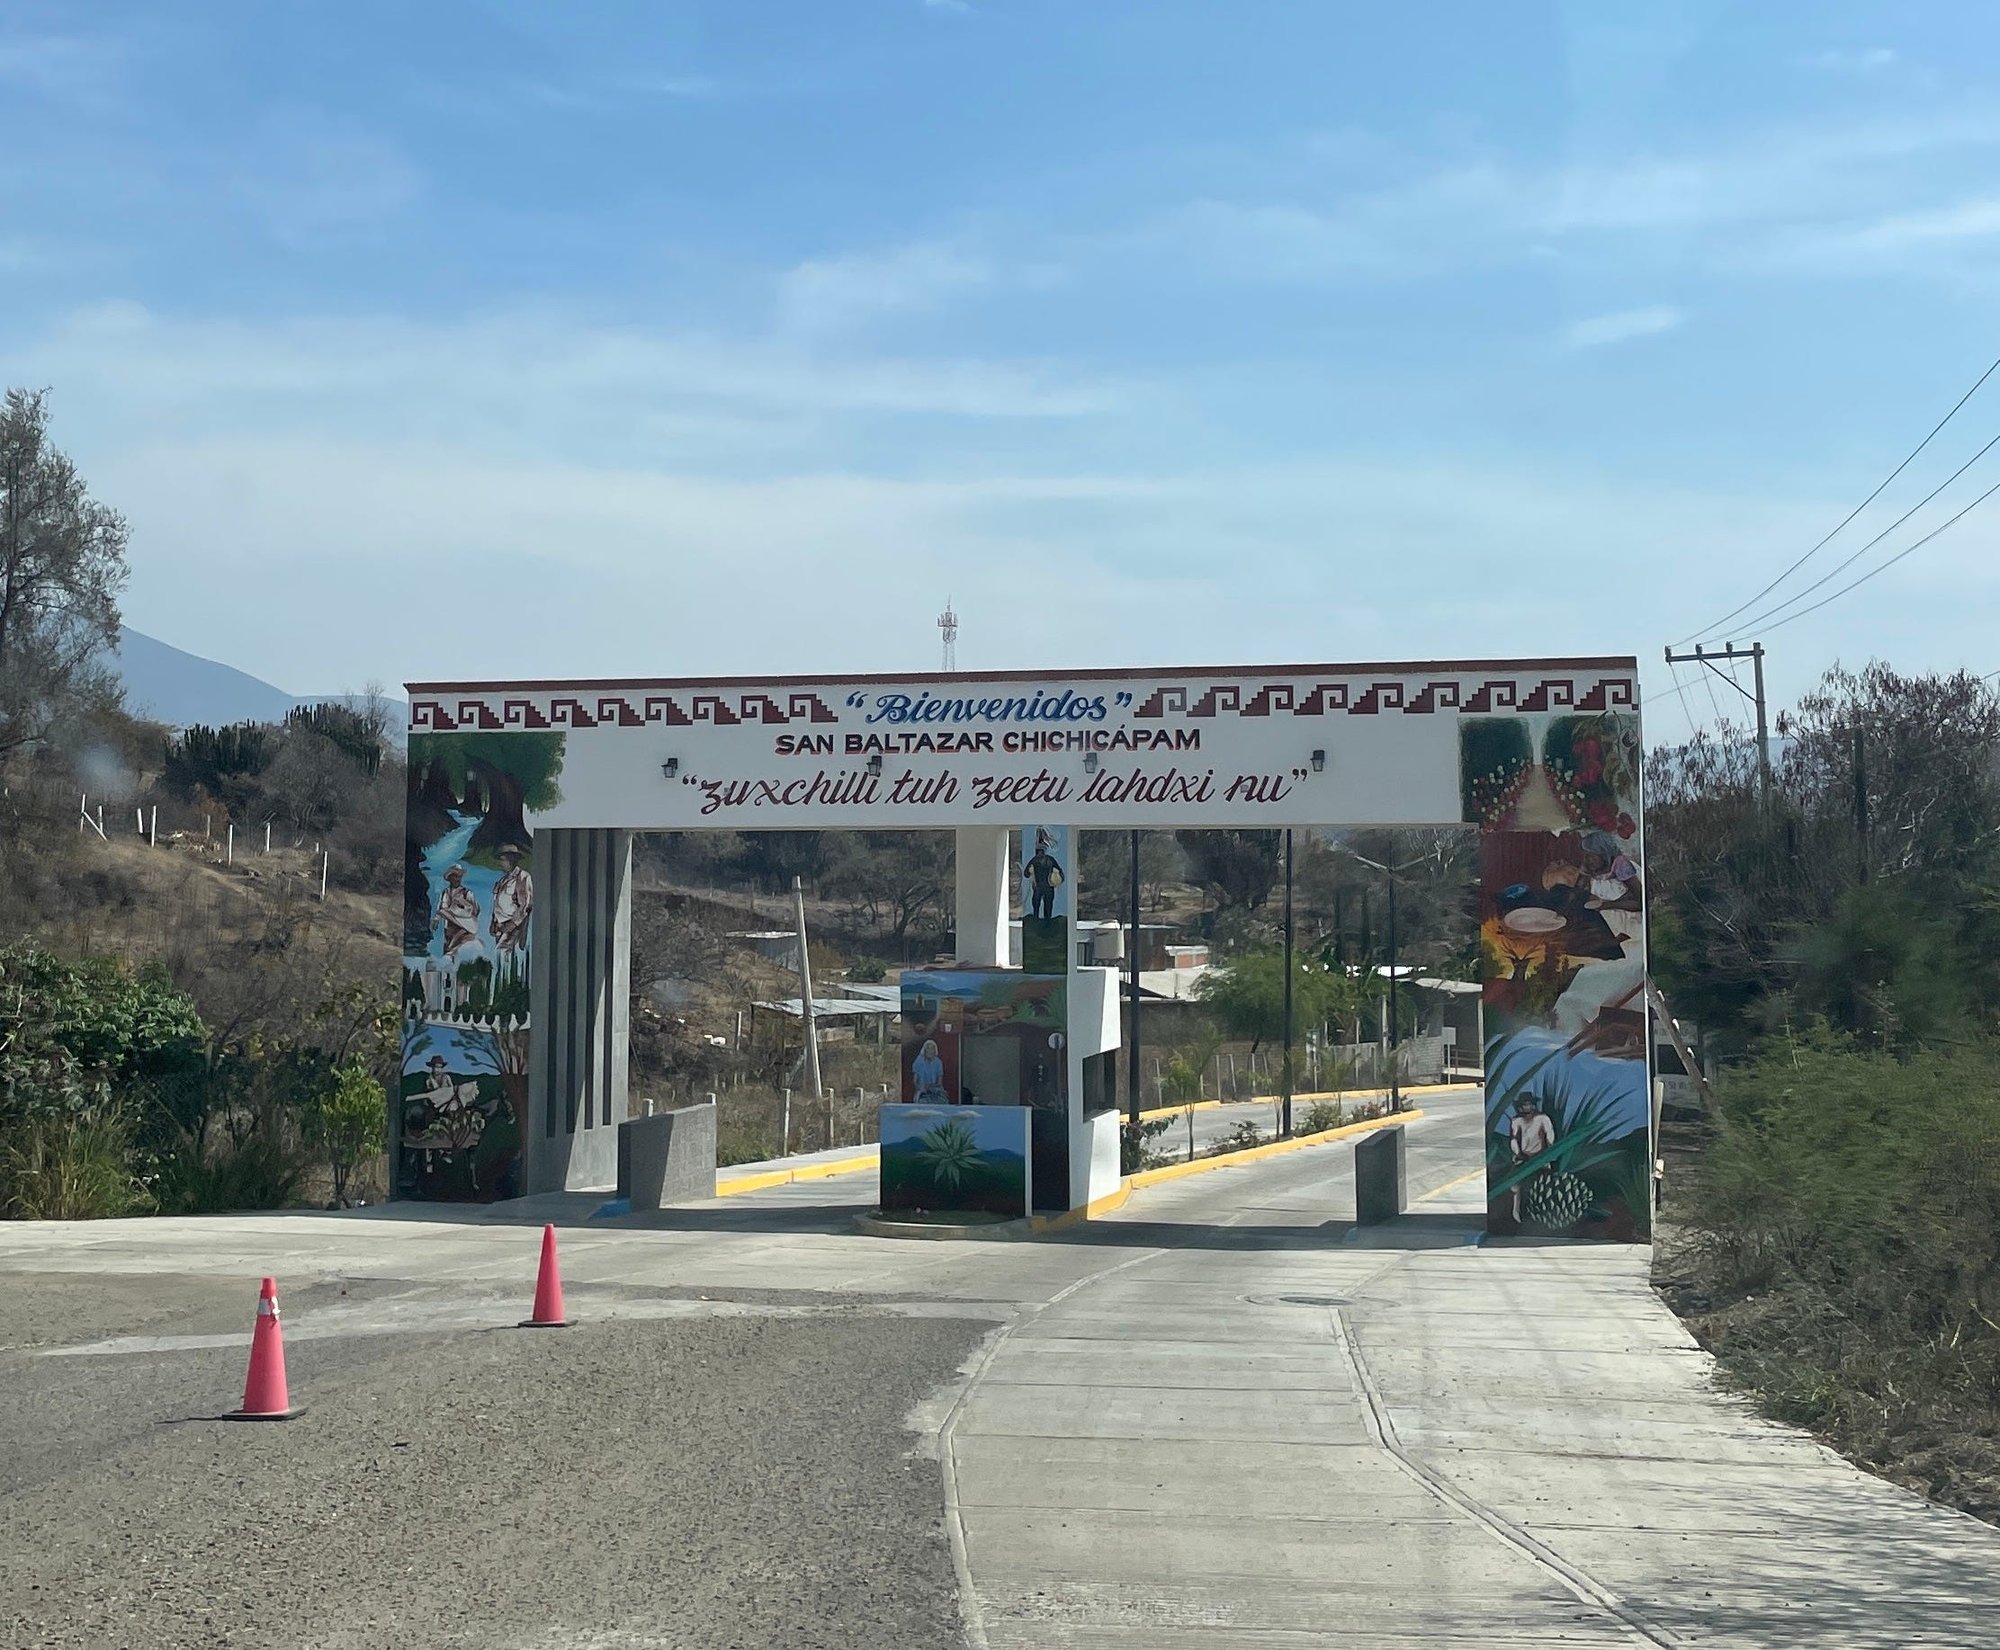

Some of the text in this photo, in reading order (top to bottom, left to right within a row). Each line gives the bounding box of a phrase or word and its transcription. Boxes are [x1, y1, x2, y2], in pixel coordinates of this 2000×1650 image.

[775, 724, 1200, 756] SAN BALTAZAR CHICHICÁPAM
[885, 769, 961, 804] tuh
[971, 768, 1073, 809] zeetu
[1076, 768, 1216, 803] lahdxi
